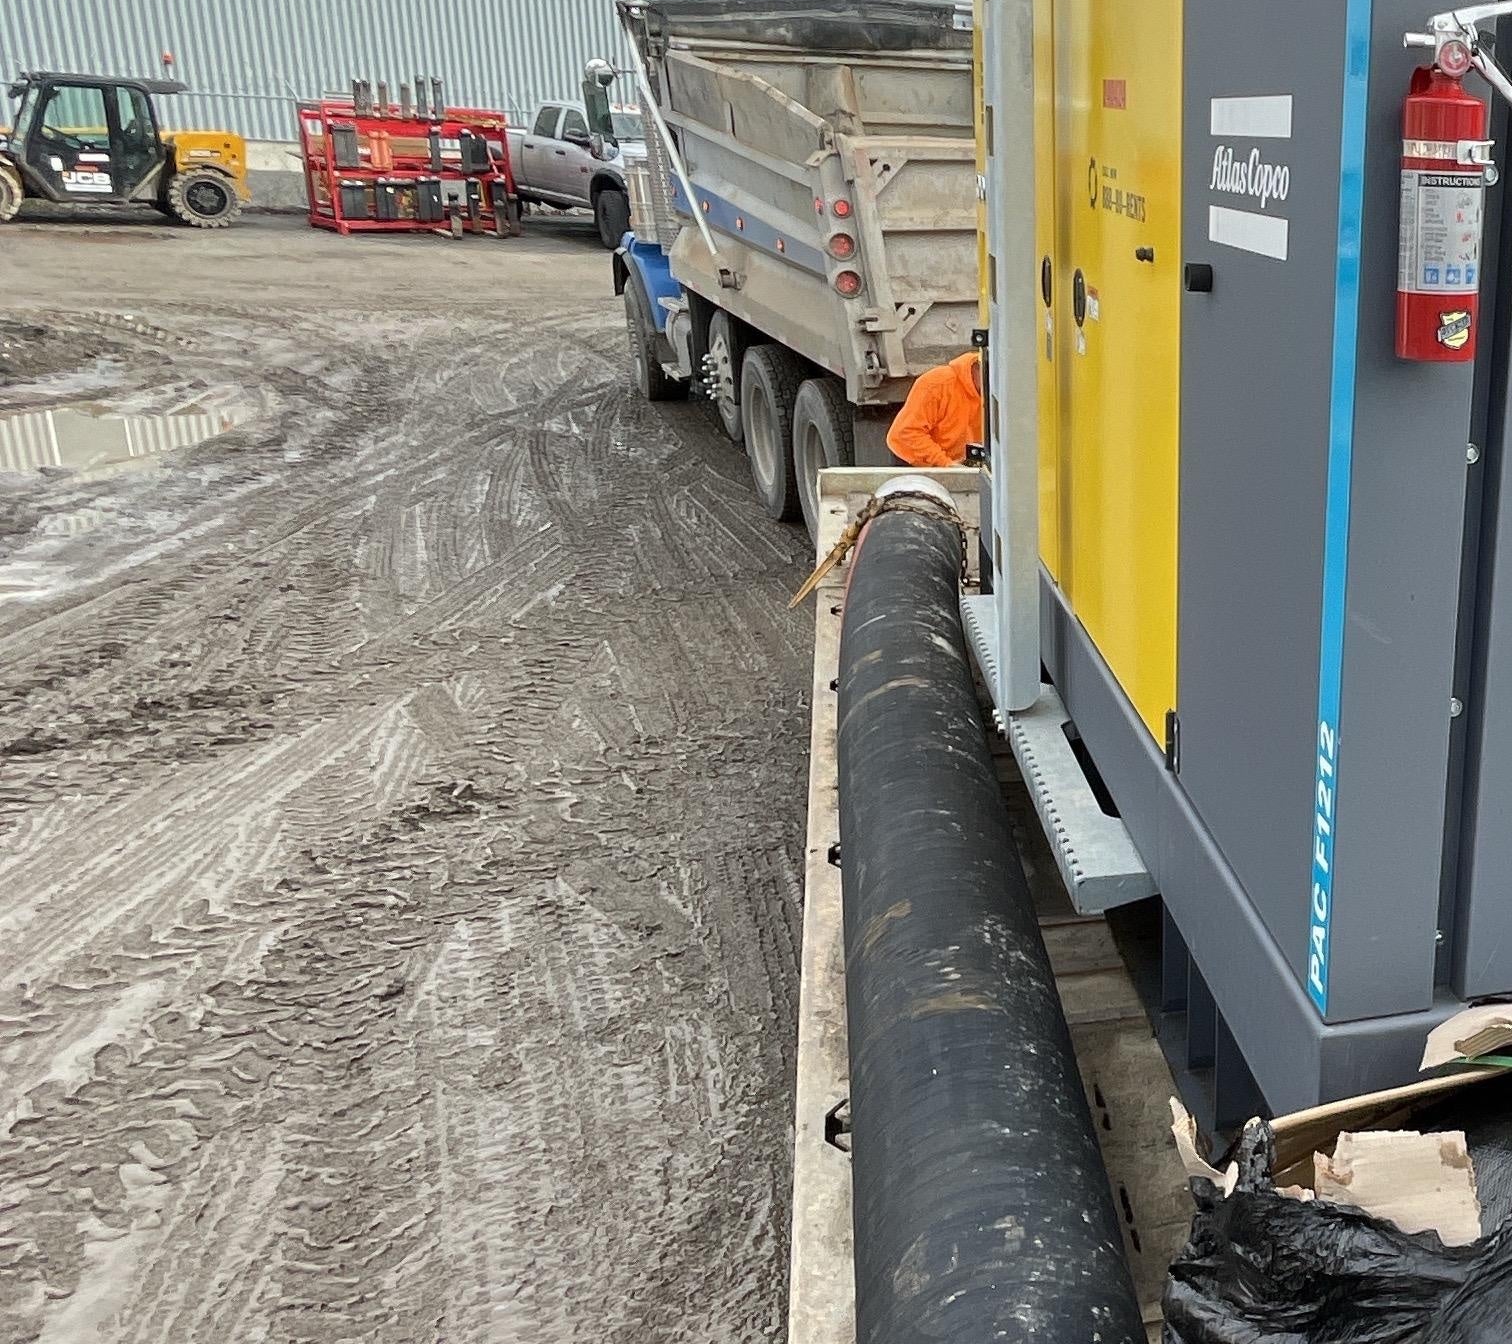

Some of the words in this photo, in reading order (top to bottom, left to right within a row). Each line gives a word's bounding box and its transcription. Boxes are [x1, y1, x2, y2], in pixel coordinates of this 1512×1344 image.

[62, 171, 111, 184] JCB
[1209, 144, 1248, 195] Atlas
[1248, 147, 1290, 209] Copco
[1315, 721, 1334, 874] F1212
[1310, 882, 1327, 995] PAC
